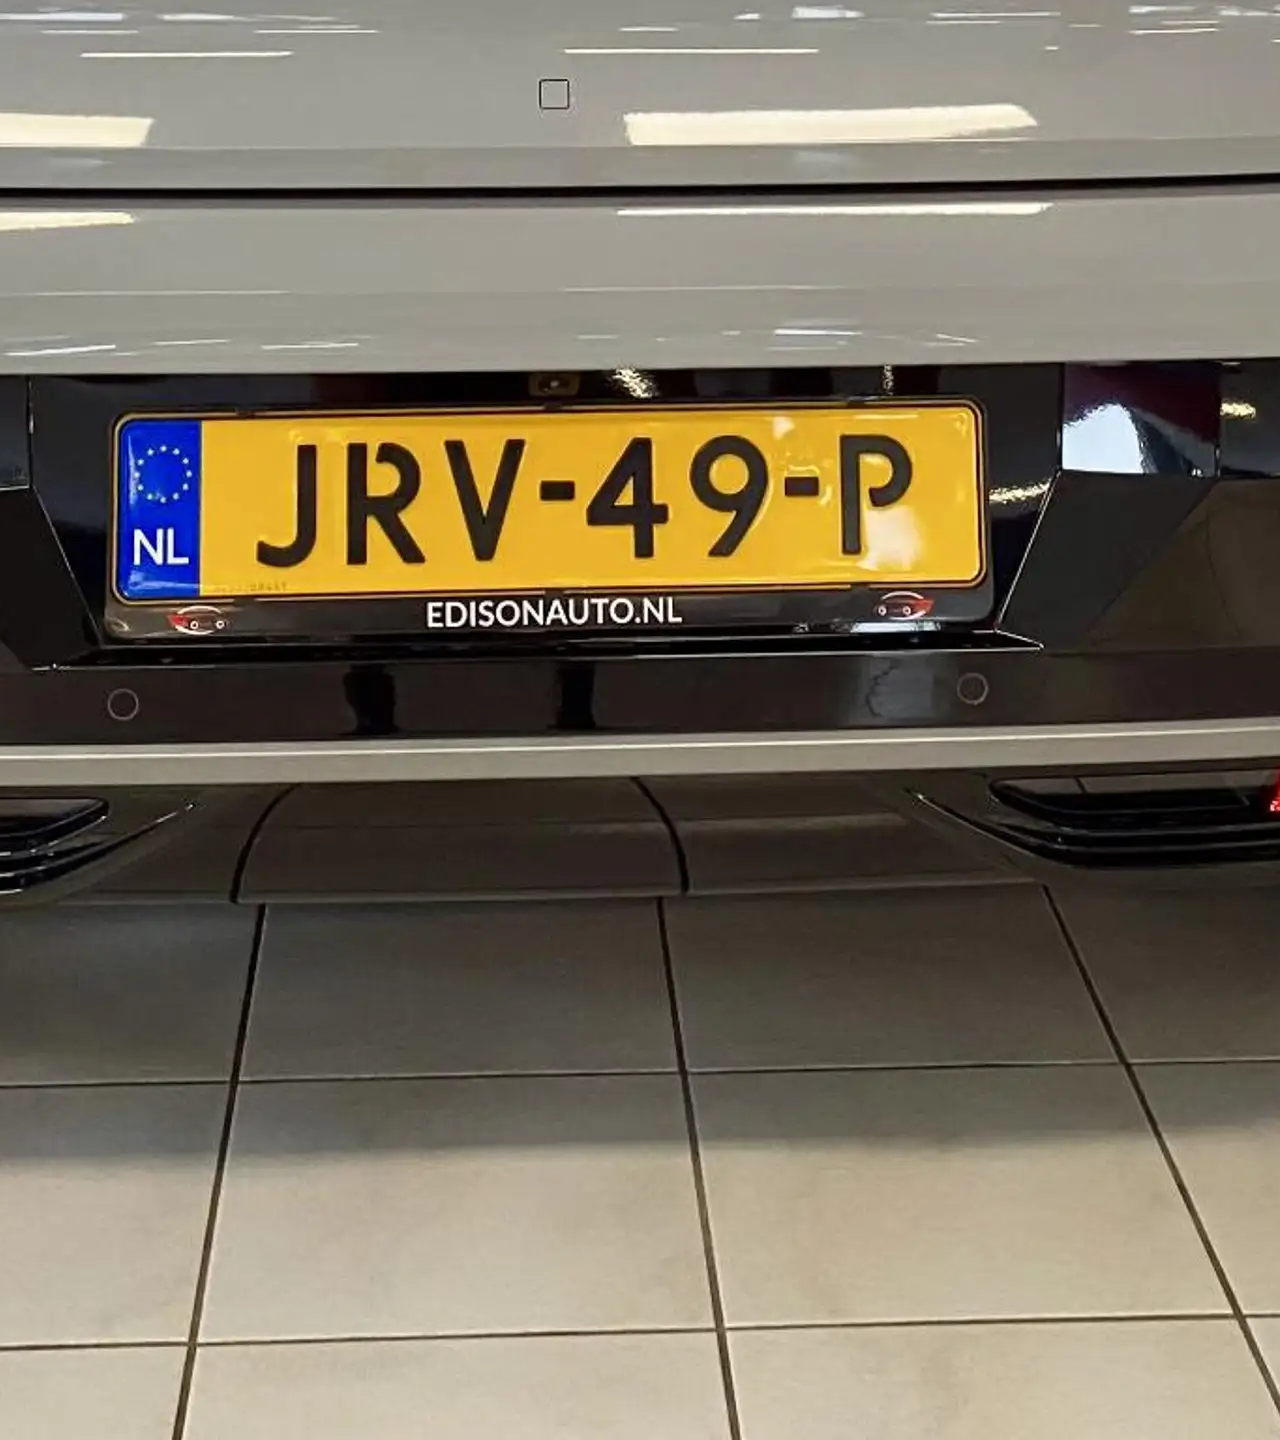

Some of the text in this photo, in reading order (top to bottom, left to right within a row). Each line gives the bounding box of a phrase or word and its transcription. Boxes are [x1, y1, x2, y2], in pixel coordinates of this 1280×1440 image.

[256, 434, 914, 568] JRV-49-P
[132, 529, 190, 567] NL
[427, 597, 683, 628] EDISONAUTO.NL
